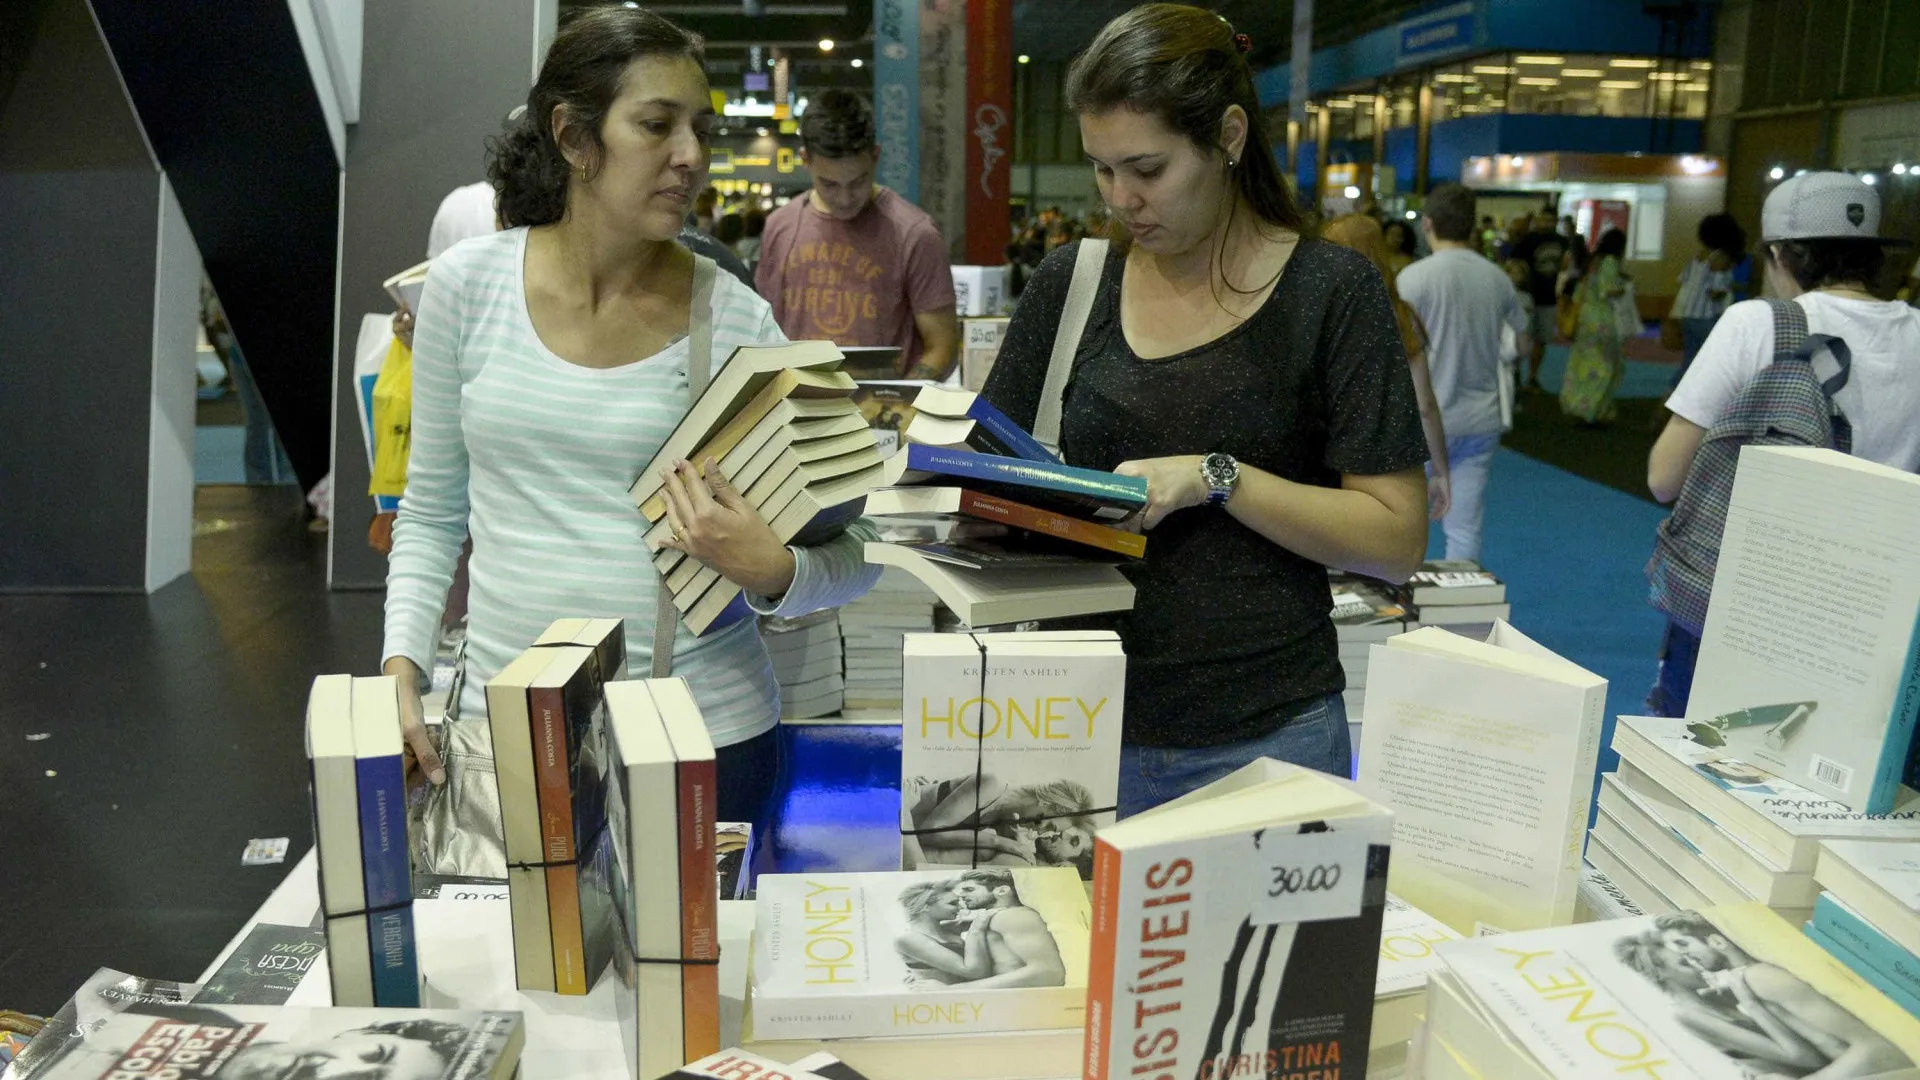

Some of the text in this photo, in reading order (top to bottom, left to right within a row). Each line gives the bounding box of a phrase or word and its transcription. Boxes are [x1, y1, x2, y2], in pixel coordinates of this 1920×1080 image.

[782, 240, 856, 270] EWARE
[783, 286, 880, 320] URFING
[995, 506, 1009, 516] COSTA
[962, 667, 1070, 677] KRSTEN ASHLEY
[544, 709, 553, 745] JULIANNA
[920, 696, 1109, 740] HONEY
[548, 745, 556, 767] COSTA
[549, 836, 567, 861] PUDO
[1565, 797, 1587, 872] HONEY
[1267, 864, 1342, 898] 30.00
[381, 913, 405, 969] VERGONHA
[804, 879, 857, 985] HONEY
[1127, 856, 1195, 1080] ISTÍVEIS
[98, 988, 155, 1004] HARVEY
[770, 1001, 985, 1027] KRISTEN ASHLEY HONEY
[1200, 1040, 1342, 1080] CHRISTINA
